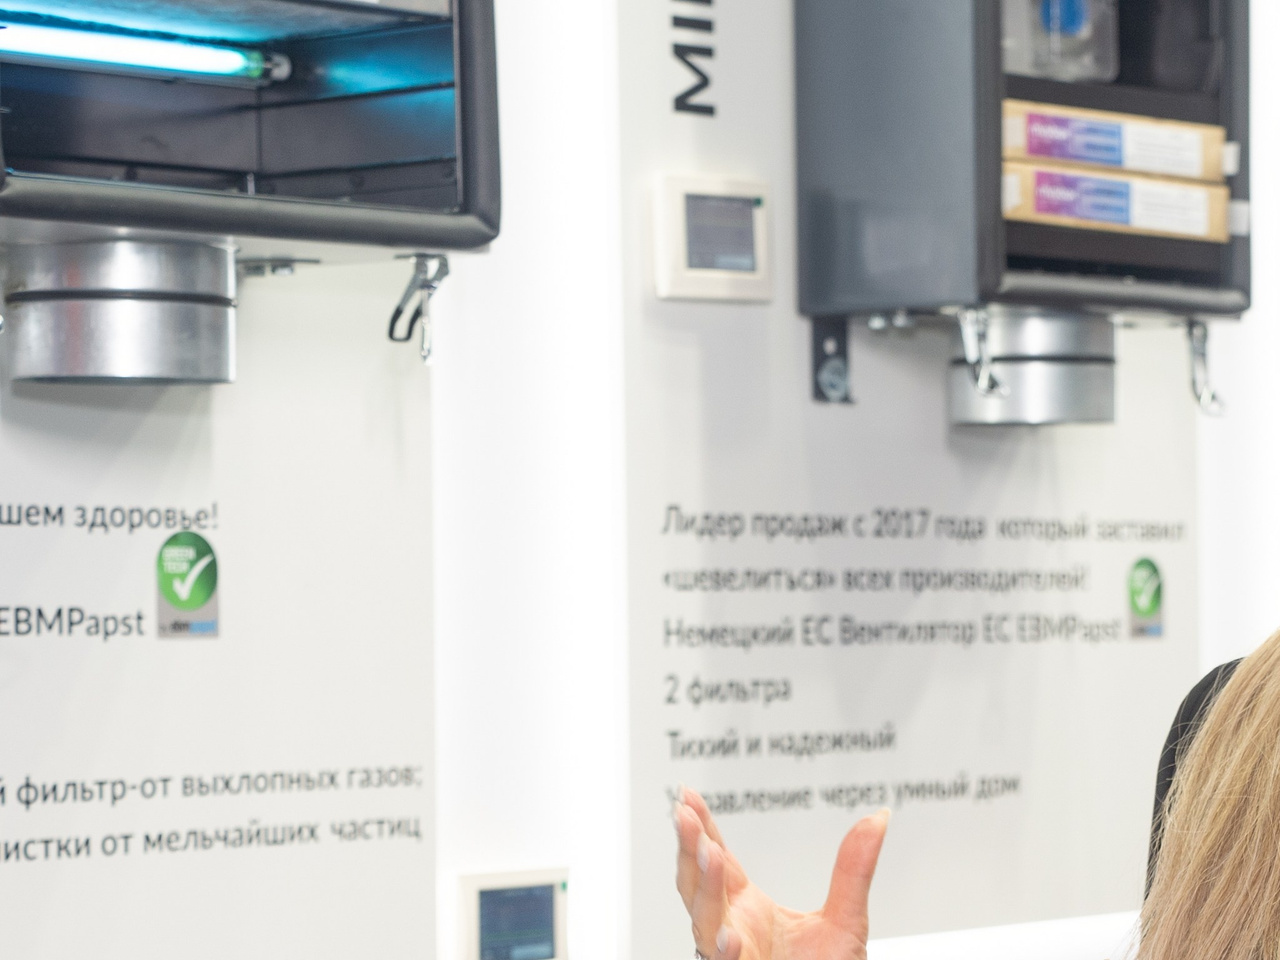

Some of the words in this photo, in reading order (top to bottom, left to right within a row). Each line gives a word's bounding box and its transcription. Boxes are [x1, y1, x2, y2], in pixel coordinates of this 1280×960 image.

[671, 0, 715, 117] MI
[74, 502, 218, 534] здоровье!
[662, 503, 747, 542] Лидер
[751, 512, 847, 543] продаж
[852, 514, 866, 538] с
[872, 507, 930, 538] 2017
[934, 516, 985, 545] года
[843, 568, 893, 592] всех
[663, 615, 796, 653] Немецкий
[838, 614, 978, 651] Вентилятор
[664, 674, 680, 704] 2
[686, 675, 793, 708] фильтра
[667, 728, 740, 760] Тихий
[746, 735, 762, 756] и
[769, 721, 896, 760] надежный
[16, 775, 172, 811] фильтр-от
[182, 771, 339, 798] выхлопных
[818, 783, 887, 811] через
[974, 773, 1021, 800] дом
[0, 836, 91, 863] истки
[101, 833, 134, 857] от
[143, 818, 319, 853] мельчайших
[330, 816, 422, 844] частиц
